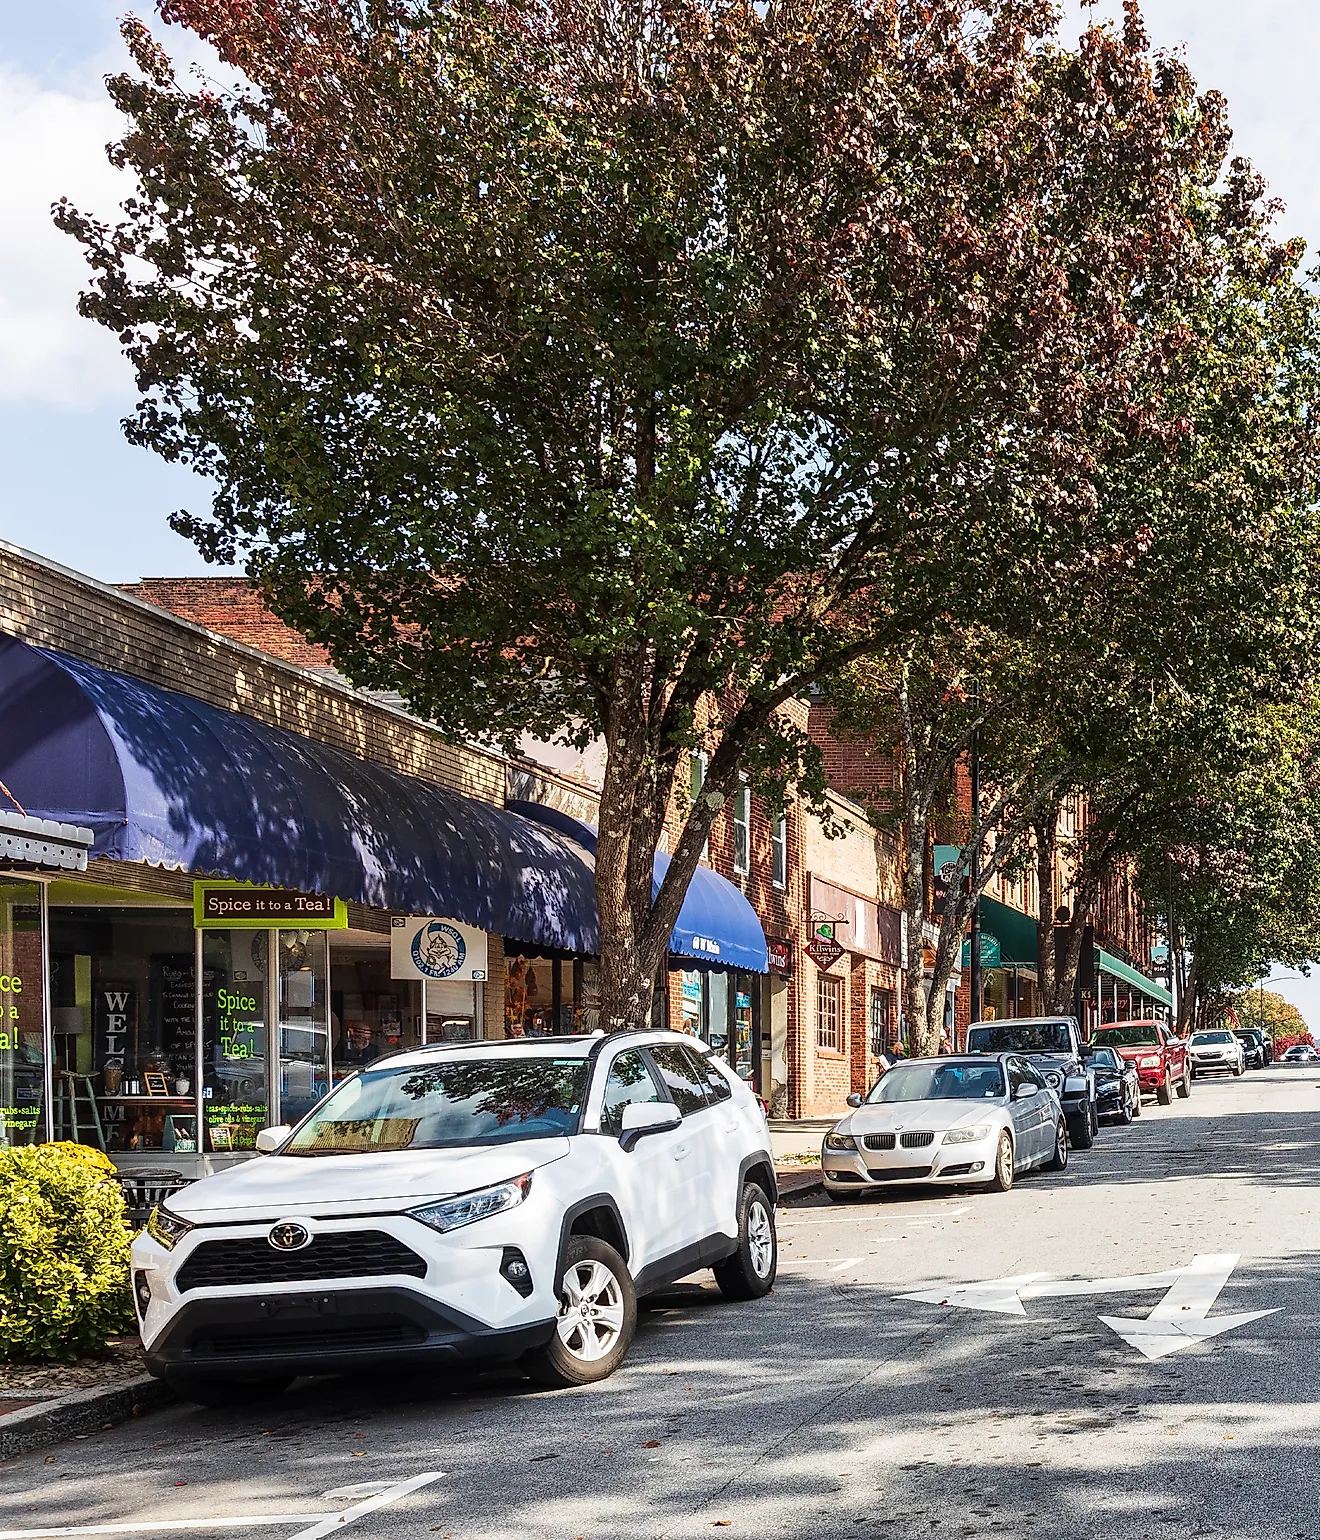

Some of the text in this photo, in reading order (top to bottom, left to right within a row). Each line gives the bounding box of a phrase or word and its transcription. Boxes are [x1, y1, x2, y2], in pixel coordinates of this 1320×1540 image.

[208, 897, 252, 915] Spice
[255, 899, 265, 911] it
[269, 900, 281, 911] to
[284, 902, 292, 911] a
[440, 924, 461, 943] WSQL
[809, 944, 843, 953] Kilwins
[457, 952, 466, 967] AM
[217, 988, 256, 1016] Spice
[220, 1016, 254, 1033] it to a
[220, 1036, 255, 1058] Tea!
[3, 1119, 37, 1130] vinegars
